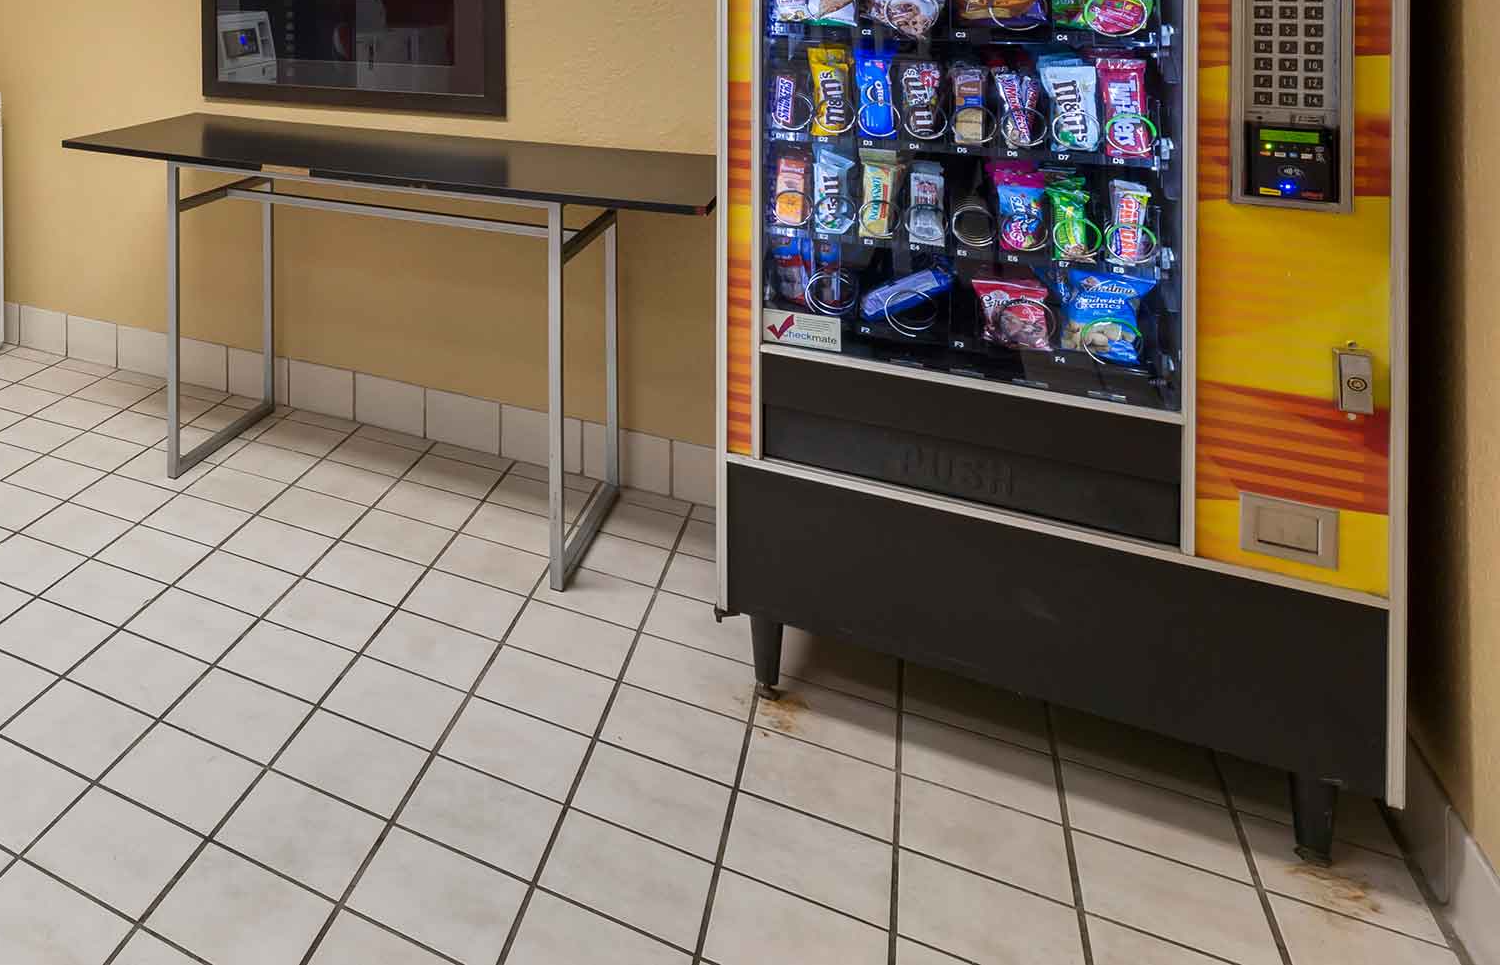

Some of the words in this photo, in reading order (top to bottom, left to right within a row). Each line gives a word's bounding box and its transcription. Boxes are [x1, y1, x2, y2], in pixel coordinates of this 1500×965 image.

[1308, 61, 1318, 69] 10
[778, 77, 794, 123] SNICKERS
[1112, 157, 1125, 165] D8
[1055, 356, 1066, 364] F4
